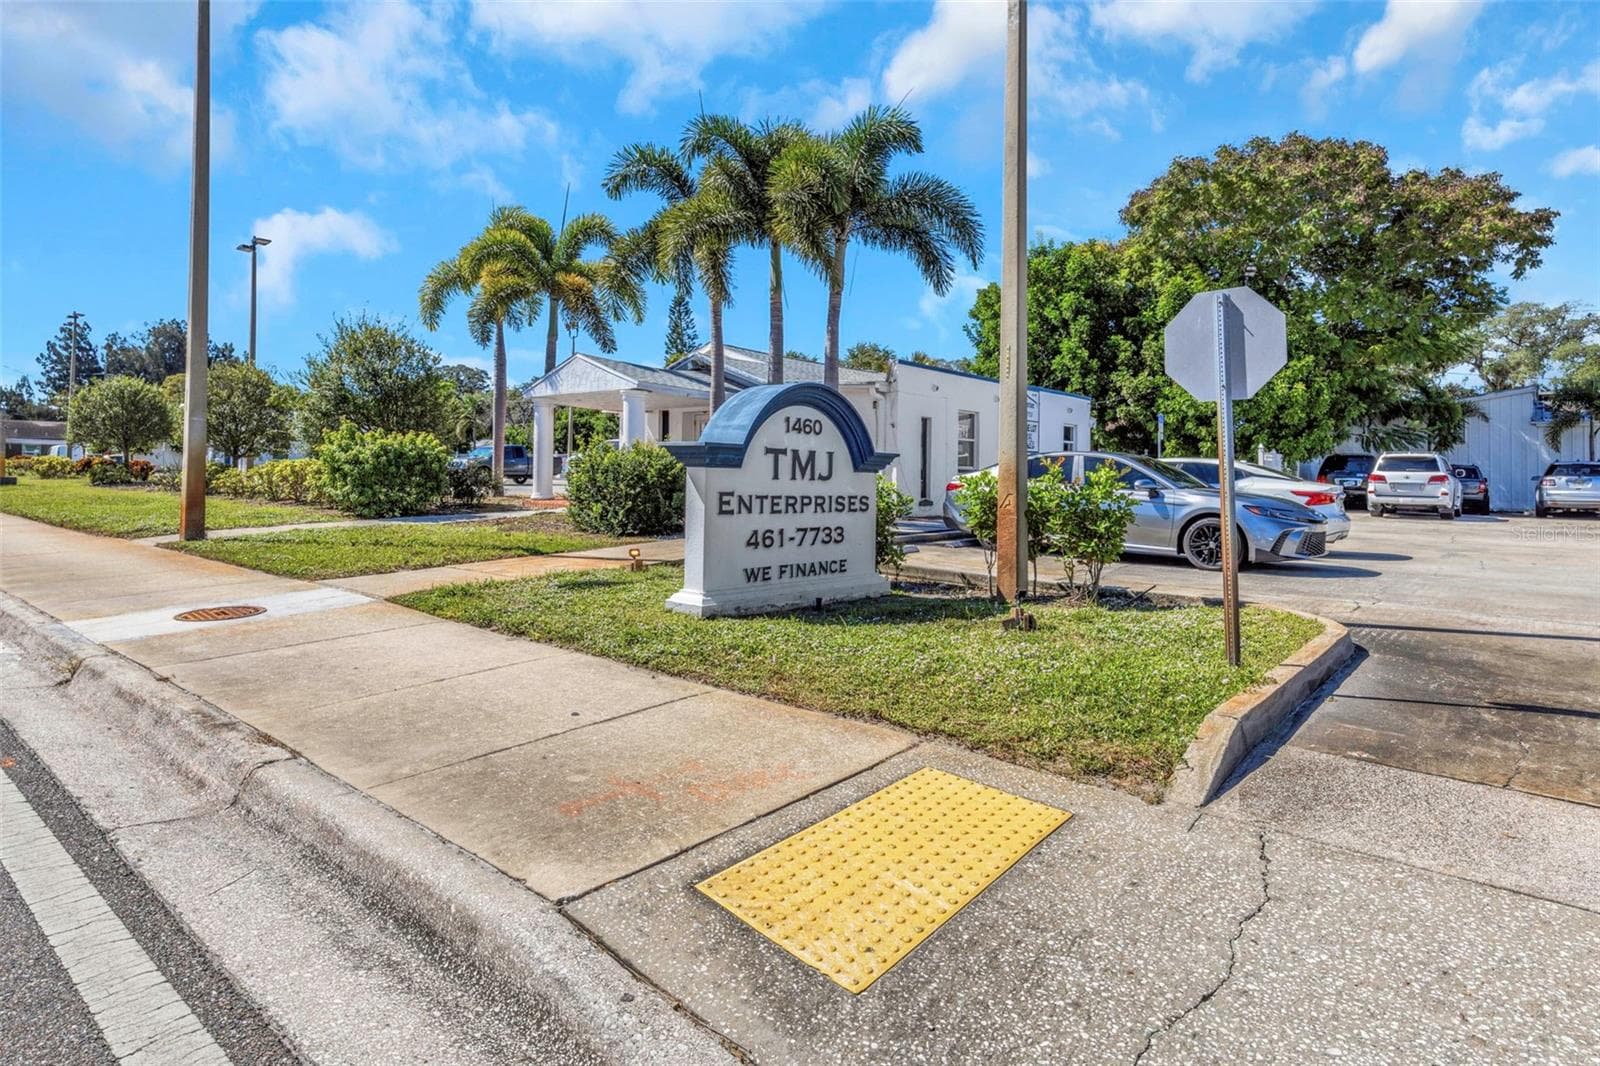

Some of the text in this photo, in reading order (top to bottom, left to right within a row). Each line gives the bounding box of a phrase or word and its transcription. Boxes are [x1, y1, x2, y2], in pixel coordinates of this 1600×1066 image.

[785, 416, 823, 435] 1460
[764, 446, 834, 481] TMJ
[717, 491, 870, 516] ENTERPRISES
[746, 526, 845, 550] 461-7733
[743, 559, 848, 583] WE FINANCE
